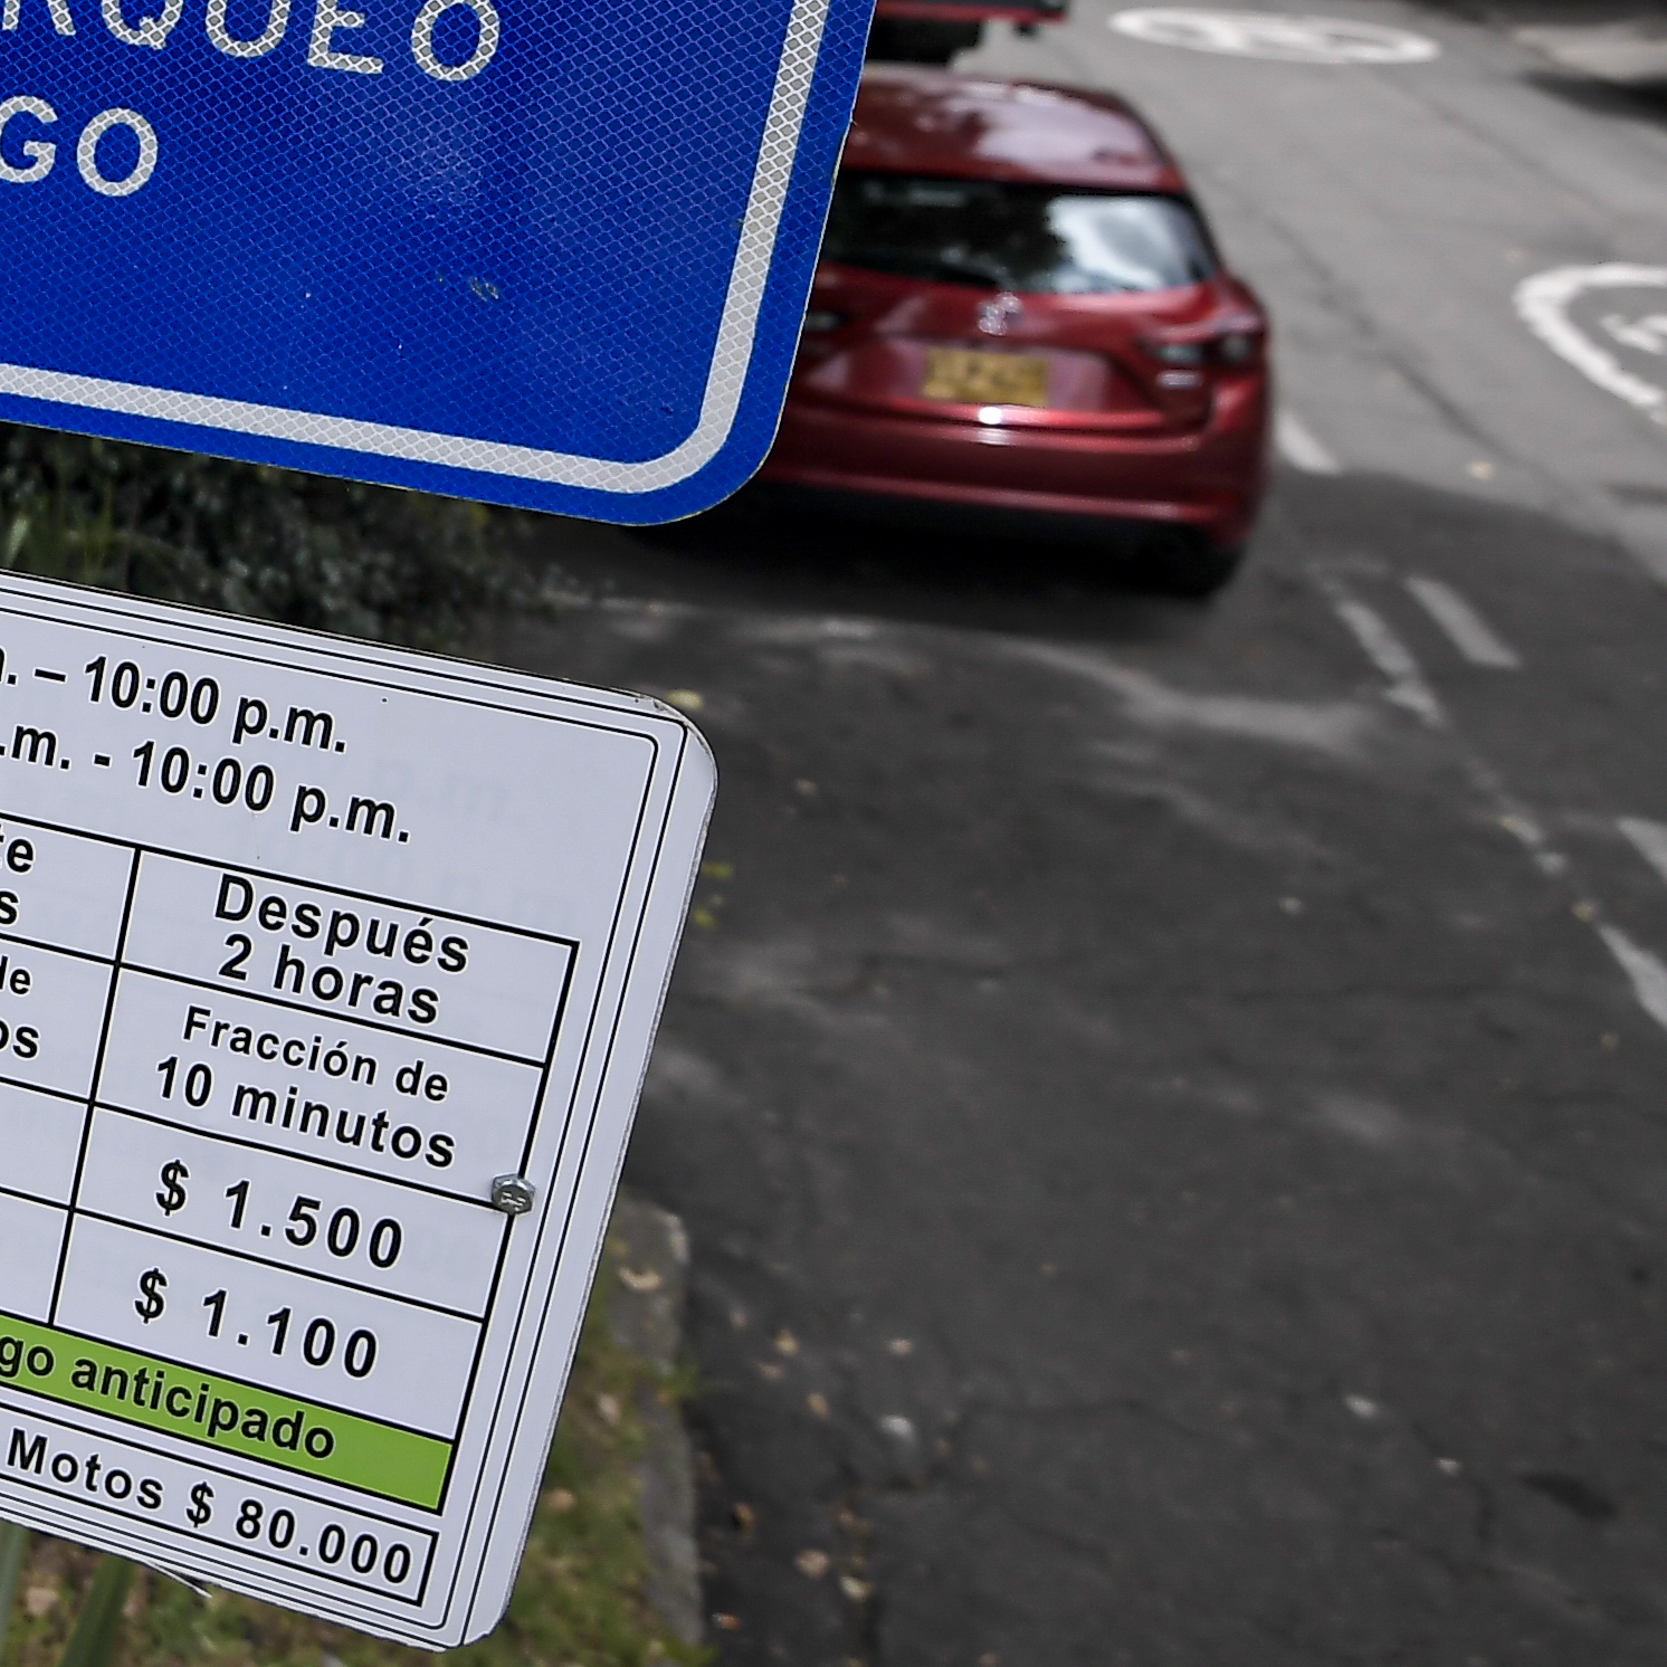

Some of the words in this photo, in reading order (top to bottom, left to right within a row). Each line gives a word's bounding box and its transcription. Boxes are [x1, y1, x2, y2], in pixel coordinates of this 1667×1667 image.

[85, 655, 219, 725] 10:00
[232, 696, 345, 753] p.m.
[93, 754, 111, 767] -
[133, 740, 274, 812] 10:00
[290, 785, 409, 843] p.m.
[214, 873, 469, 973] Después
[218, 933, 252, 981] 2
[273, 943, 439, 1024] horas
[183, 1005, 377, 1086] Fracción
[395, 1060, 448, 1102] de
[157, 1056, 212, 1107] 10
[231, 1084, 455, 1168] minutos
[155, 1159, 189, 1217] $
[225, 1180, 402, 1269] 1.500
[134, 1267, 167, 1325] $
[203, 1289, 377, 1378] 1.100
[71, 1358, 335, 1459] anticipado
[7, 1427, 163, 1510] Motos
[186, 1481, 214, 1529] $
[235, 1497, 411, 1585] 80.000
